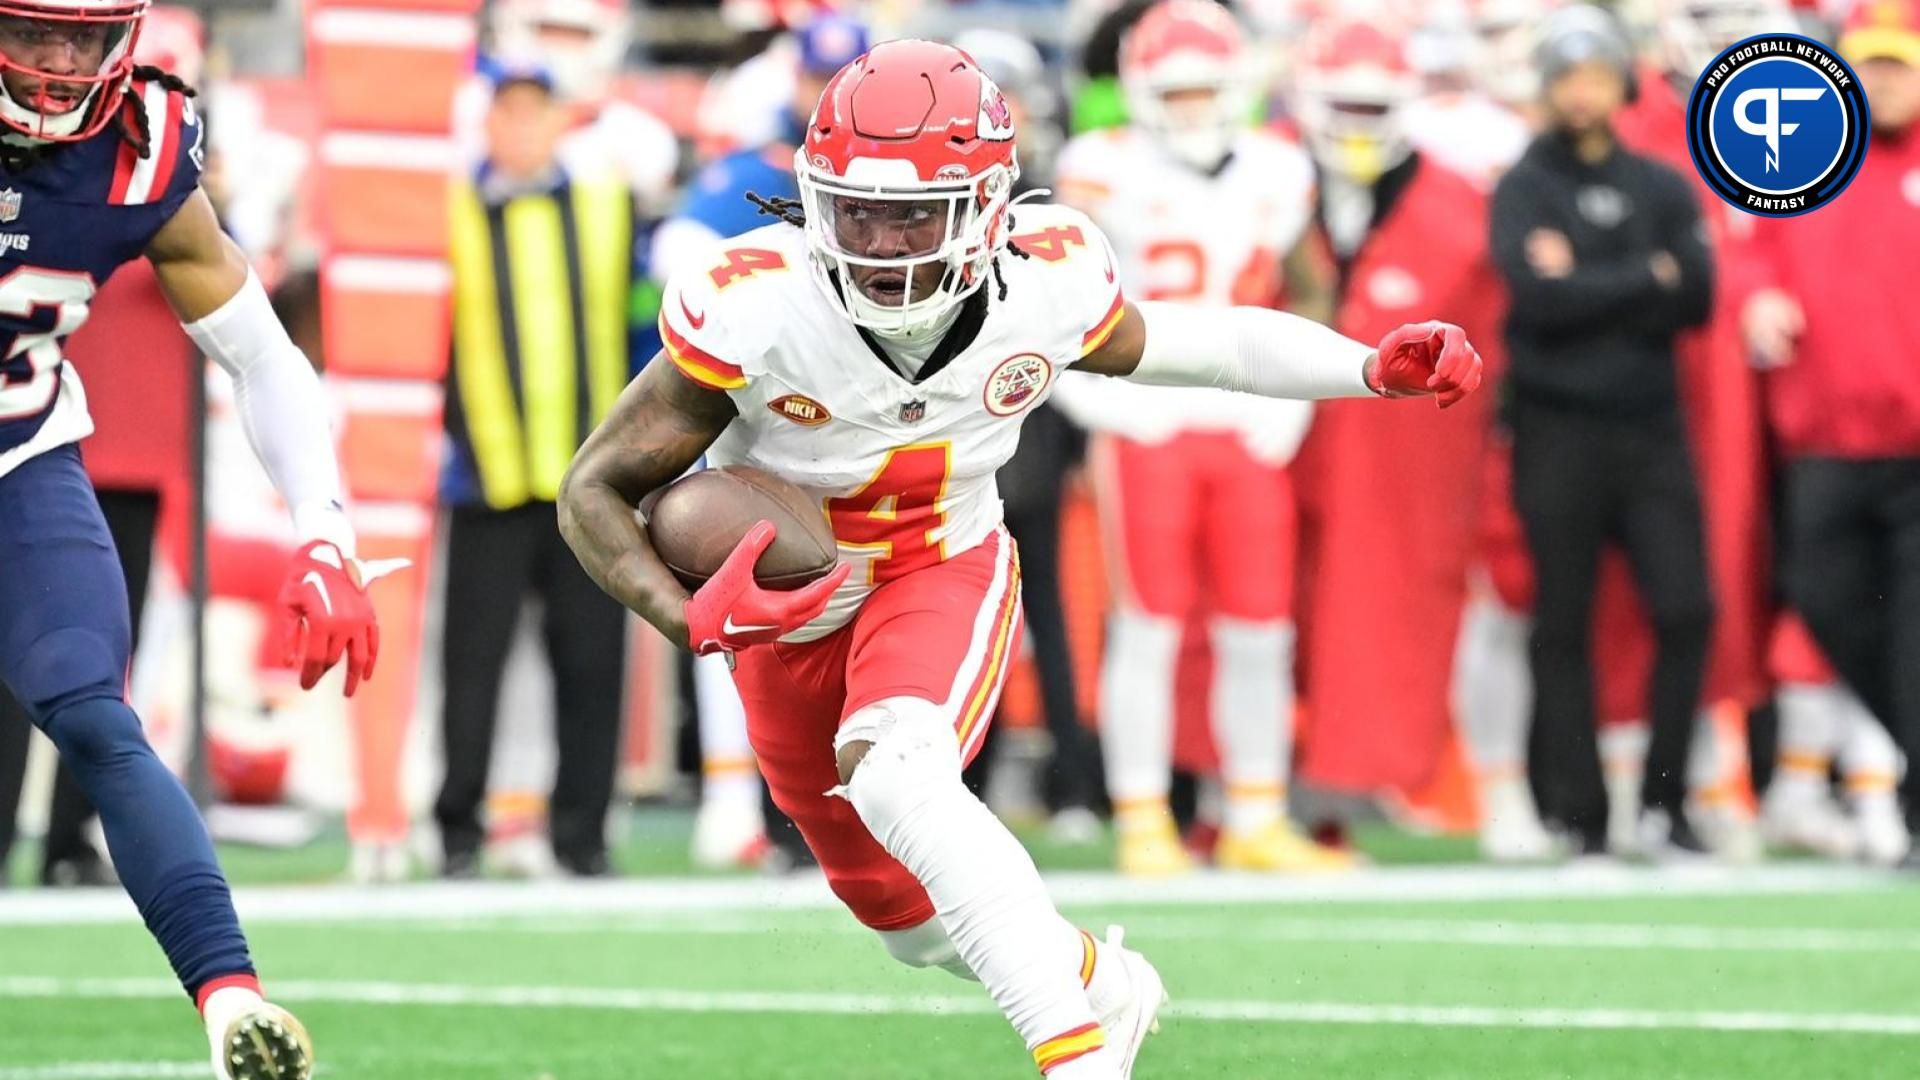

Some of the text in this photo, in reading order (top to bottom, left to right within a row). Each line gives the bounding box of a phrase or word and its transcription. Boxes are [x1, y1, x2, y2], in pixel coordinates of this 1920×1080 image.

[1007, 224, 1087, 264] 4
[707, 246, 787, 293] 4
[995, 360, 1040, 400] A
[783, 399, 817, 420] NKH
[821, 440, 953, 586] 4
